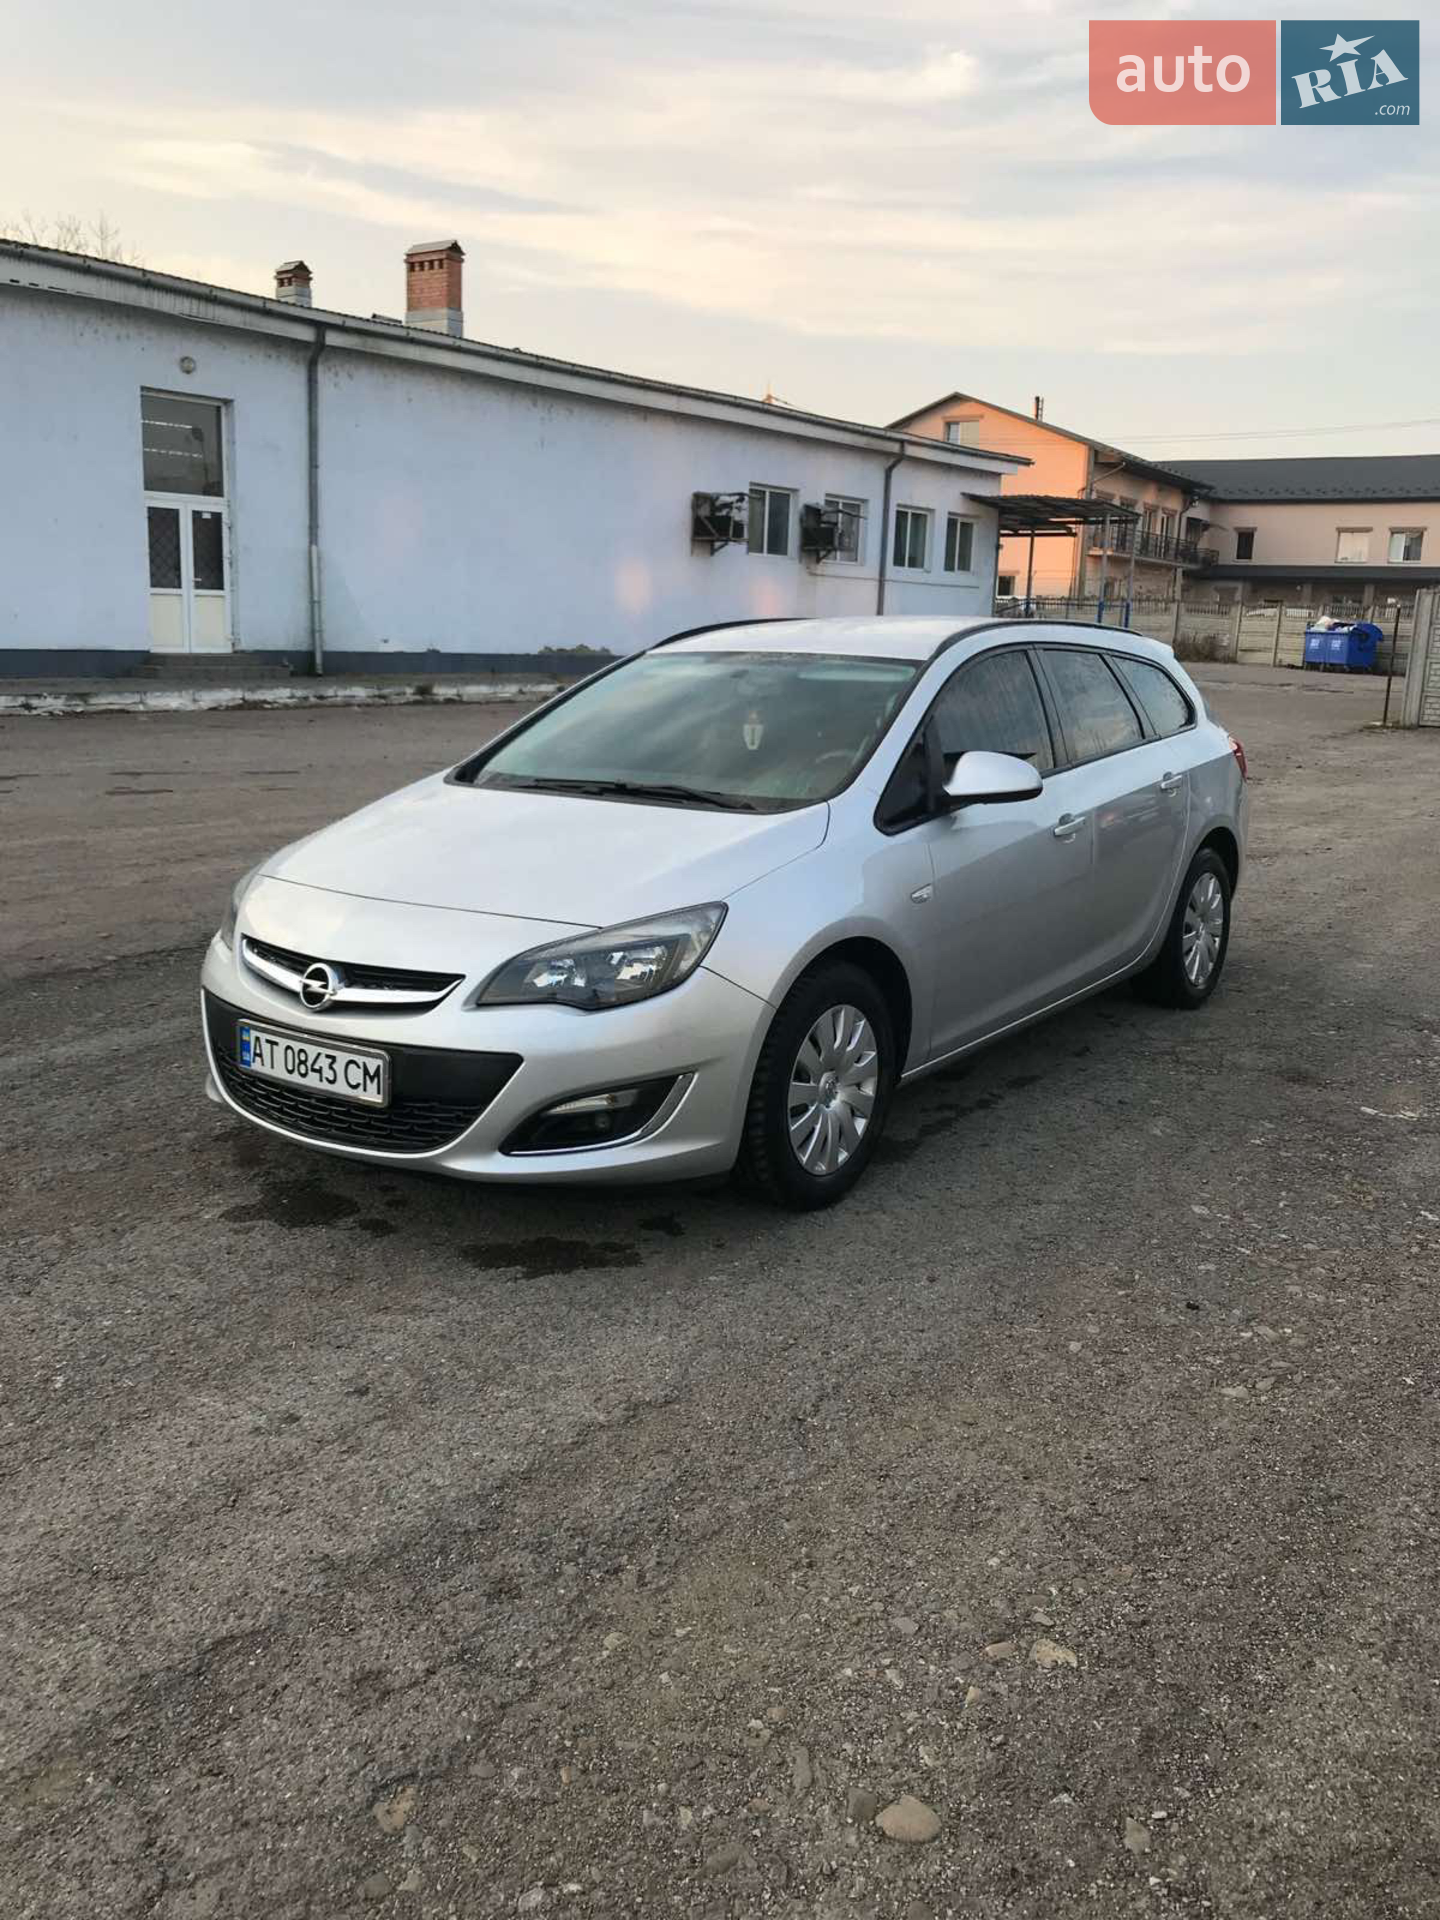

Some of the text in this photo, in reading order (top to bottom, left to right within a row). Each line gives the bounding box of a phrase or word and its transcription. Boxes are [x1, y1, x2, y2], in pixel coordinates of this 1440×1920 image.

[252, 1036, 382, 1095] AT 0843 CM
